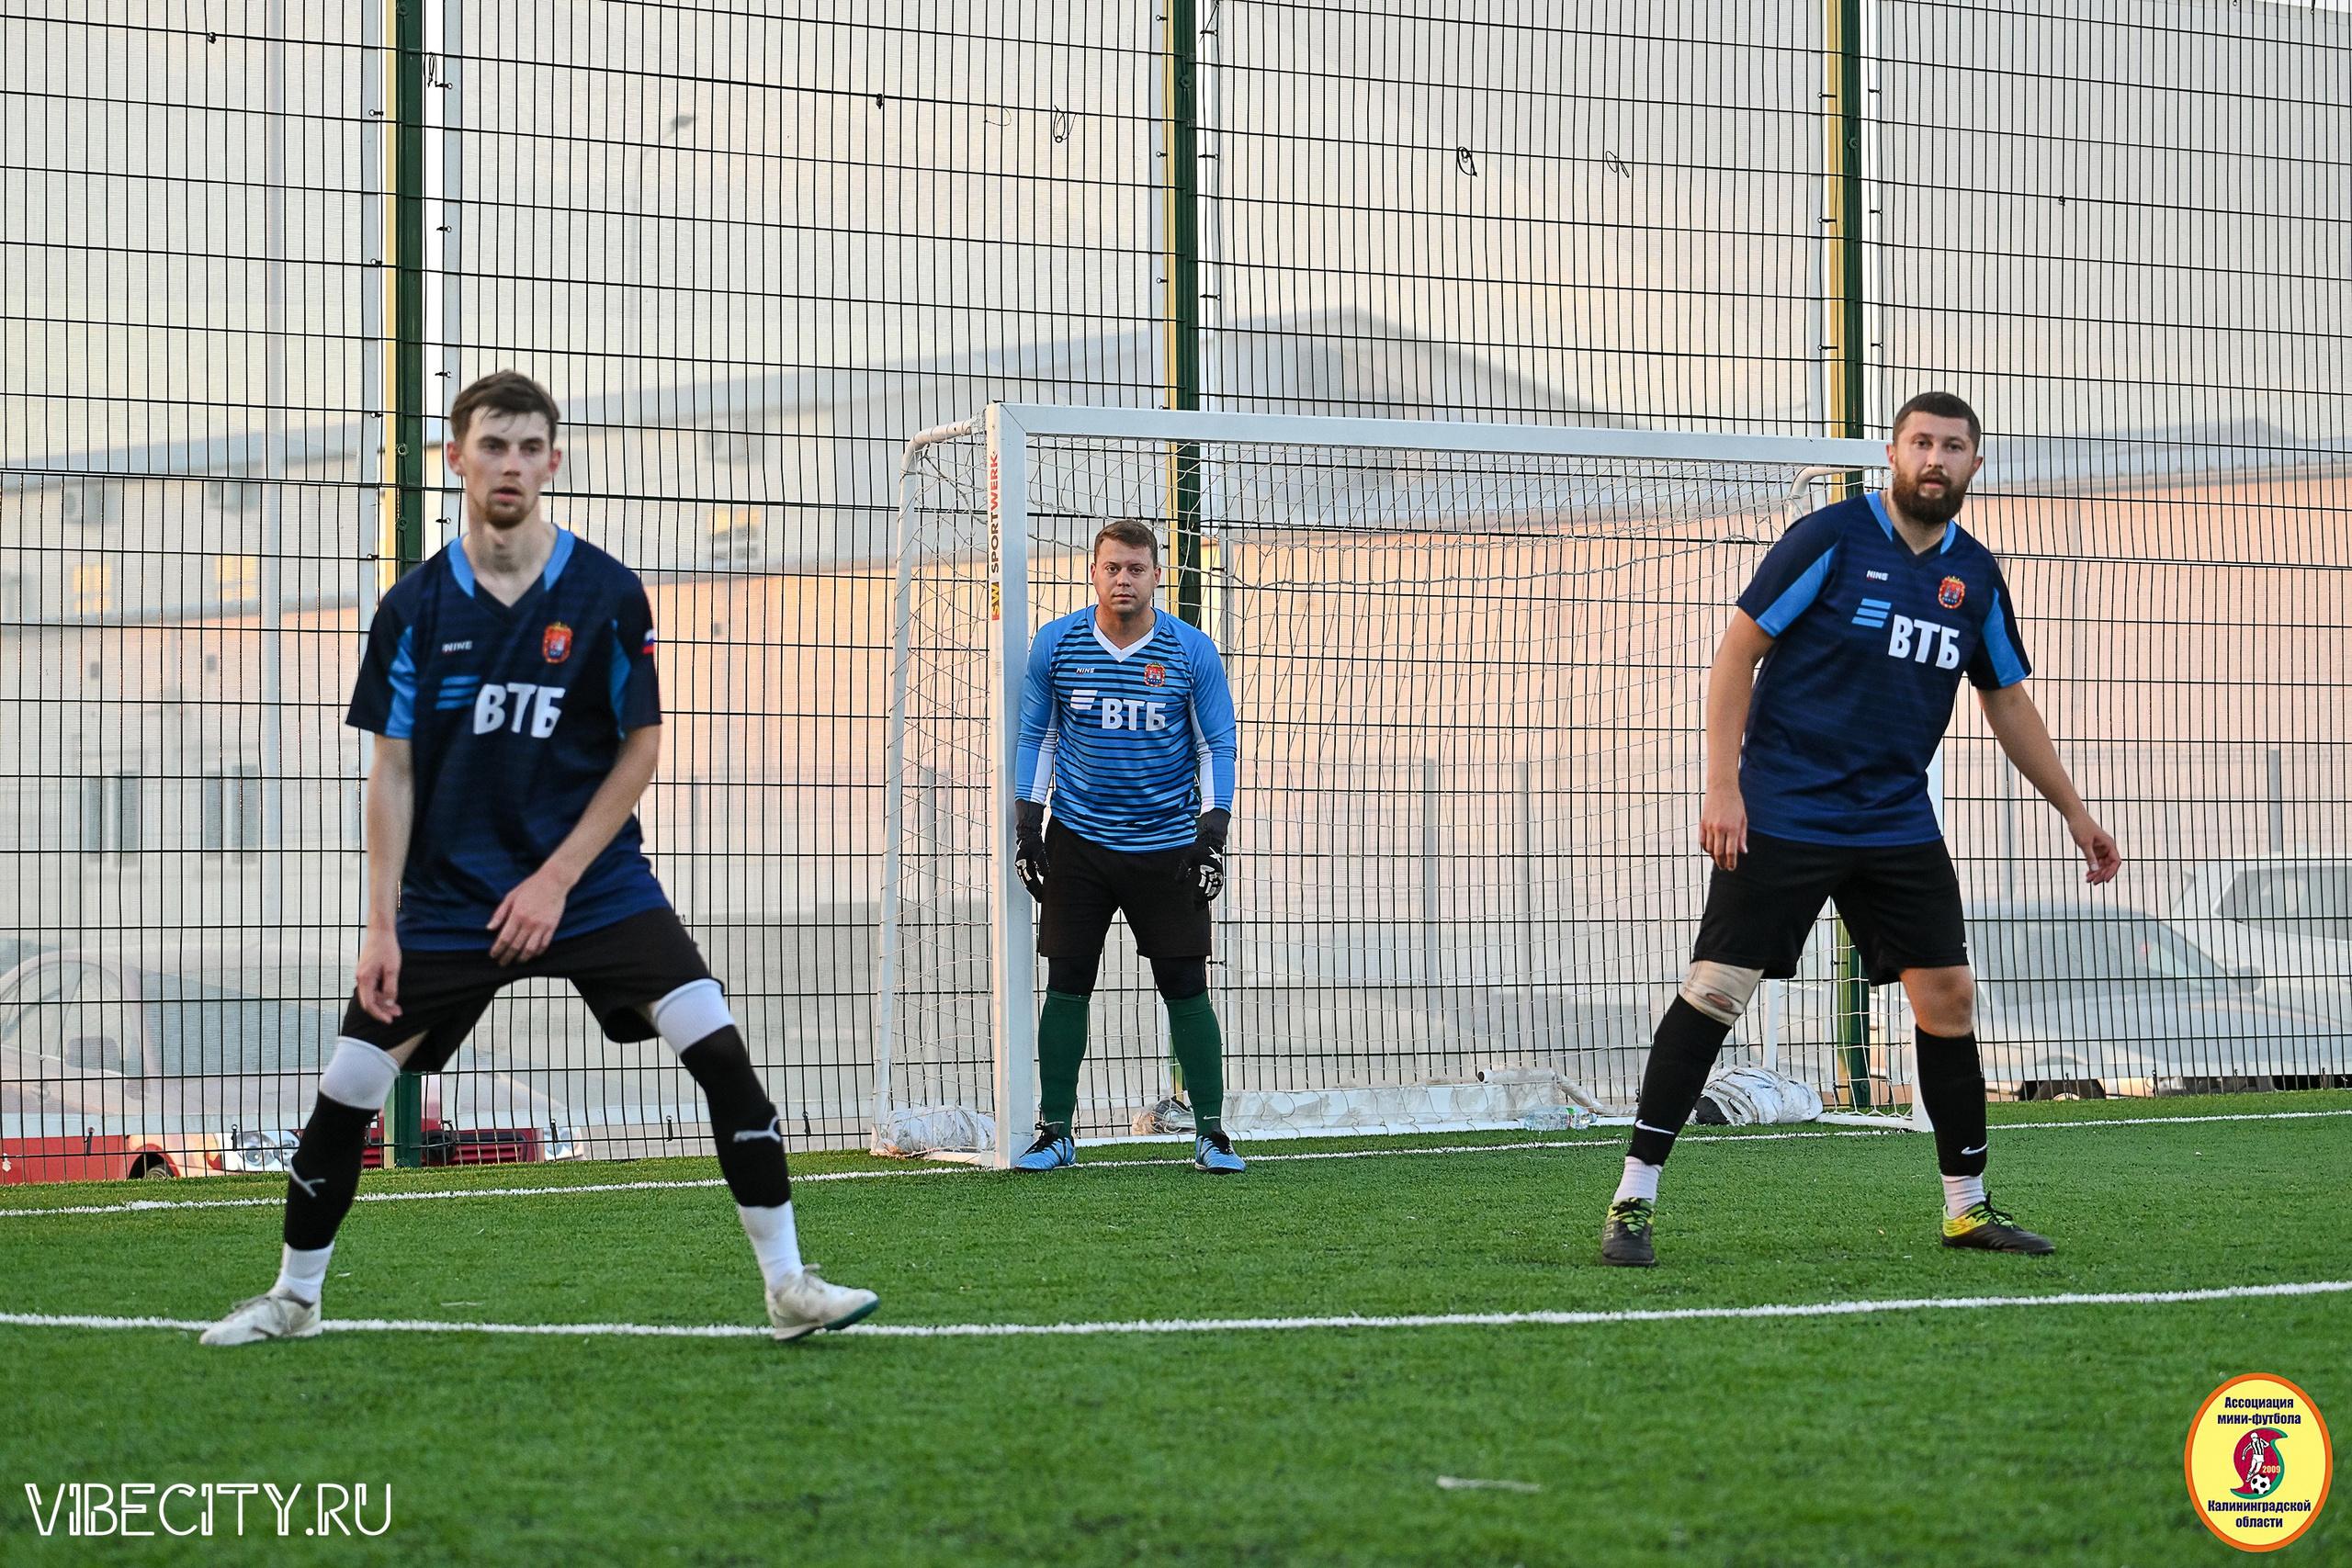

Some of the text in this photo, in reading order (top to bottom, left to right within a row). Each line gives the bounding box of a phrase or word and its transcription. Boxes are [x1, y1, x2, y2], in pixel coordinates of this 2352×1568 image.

[990, 454, 1000, 574] SPORTWERK
[1888, 614, 1960, 670] ВТБ
[473, 682, 566, 739] ВТБ
[1102, 697, 1167, 732] ВТБ
